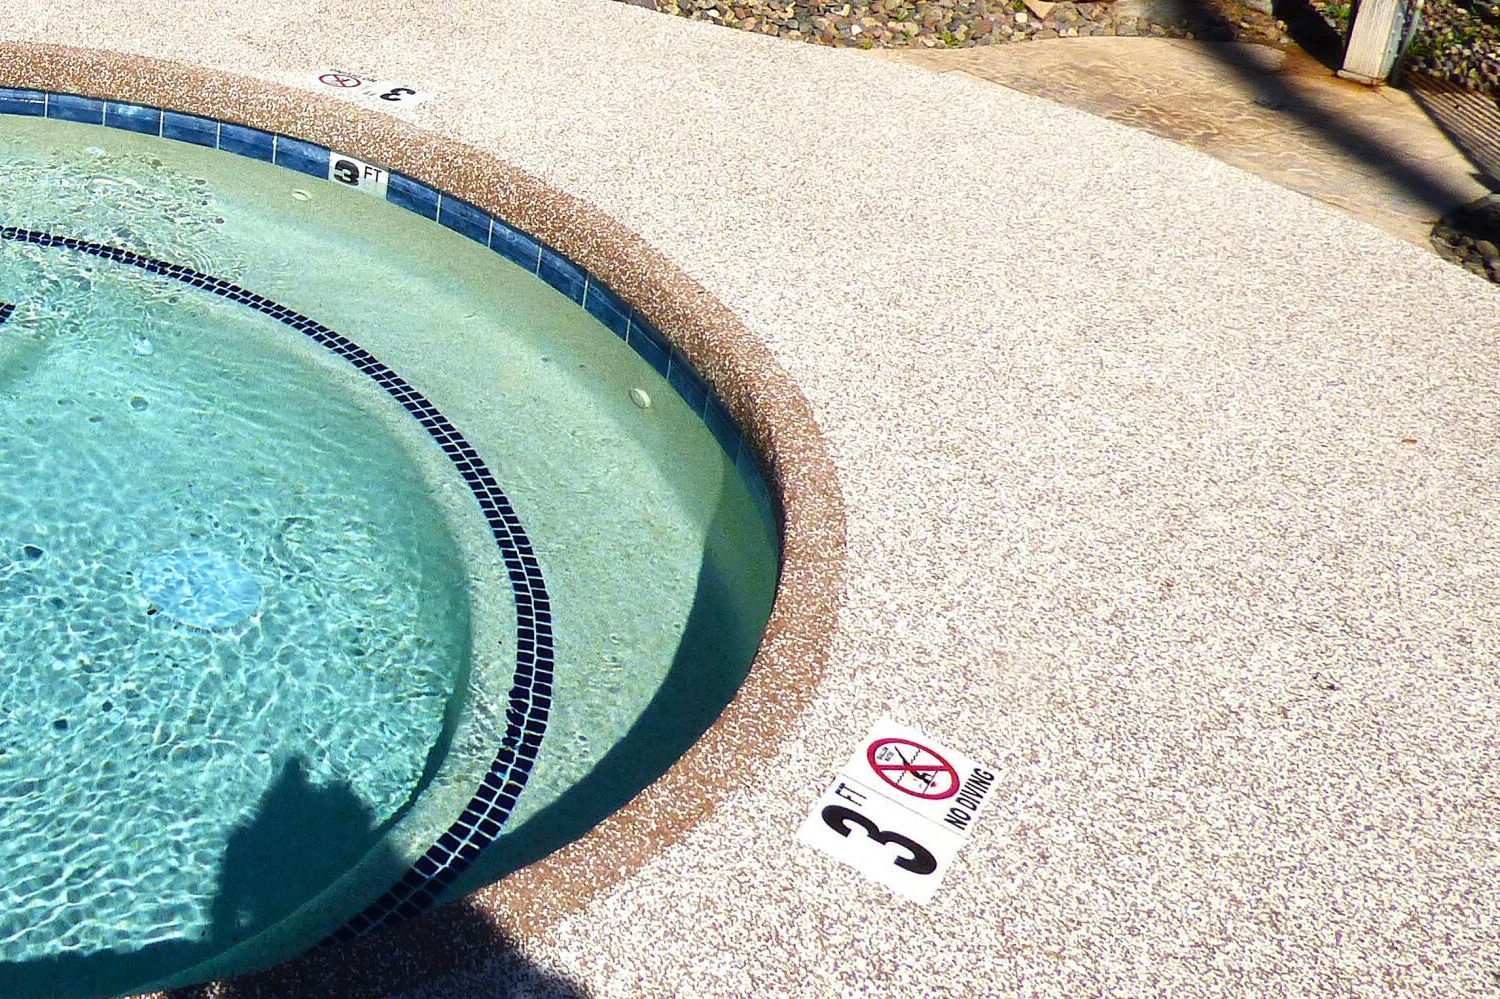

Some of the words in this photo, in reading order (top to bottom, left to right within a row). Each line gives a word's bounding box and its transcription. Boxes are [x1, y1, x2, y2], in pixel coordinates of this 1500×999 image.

[379, 87, 416, 102] 3
[333, 159, 360, 187] 3
[364, 166, 383, 183] FT
[835, 782, 868, 807] FT
[955, 767, 995, 812] DIVING
[943, 807, 972, 831] NO
[821, 804, 938, 875] 3
